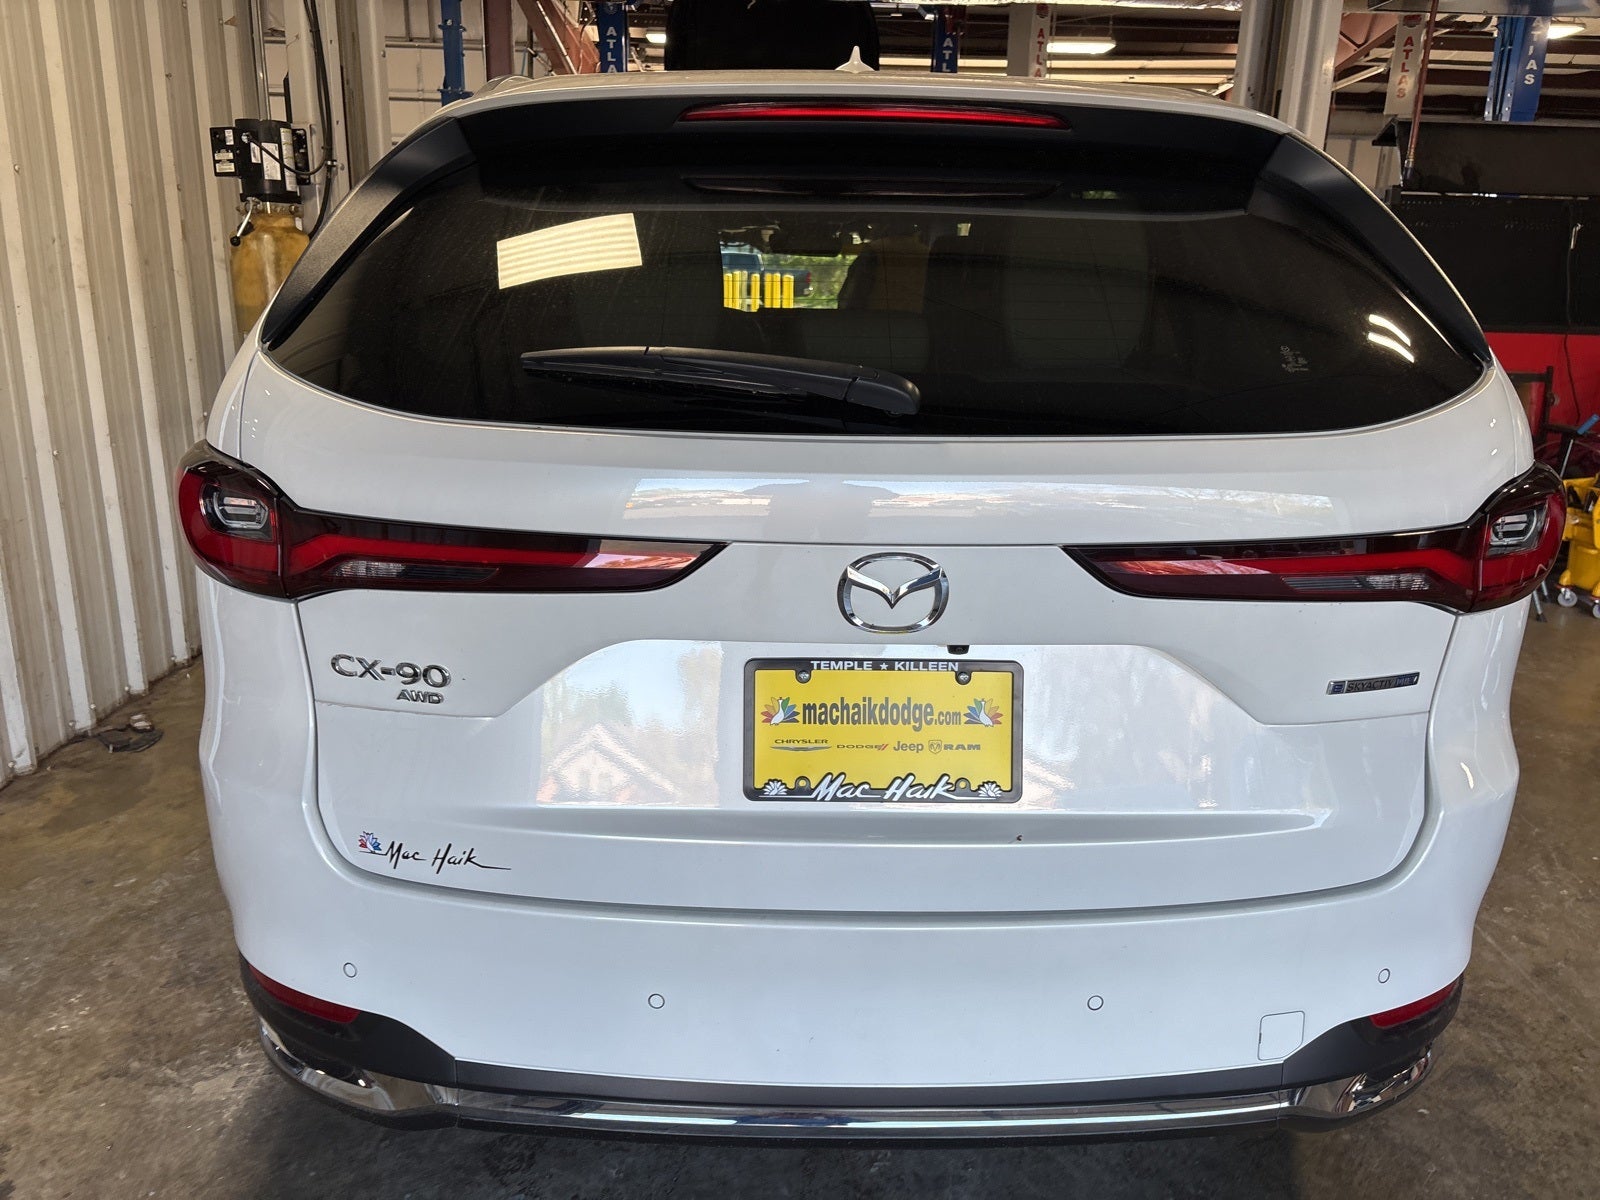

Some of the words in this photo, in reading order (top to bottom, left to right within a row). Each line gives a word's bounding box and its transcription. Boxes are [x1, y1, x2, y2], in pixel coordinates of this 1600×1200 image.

[606, 26, 617, 73] ATLA
[942, 37, 953, 72] ATL
[1034, 28, 1045, 77] ATLA
[1396, 35, 1414, 98] ATLAS
[331, 653, 451, 688] CX-90
[811, 660, 873, 670] TEMPLE
[895, 661, 959, 671] KILLEEN
[396, 689, 444, 704] AWD
[802, 696, 961, 732] machaikdodge.com
[893, 741, 924, 753] Jeep
[811, 774, 881, 801] Mac
[882, 775, 957, 802] Haik
[385, 841, 426, 870] Mac
[432, 843, 511, 874] Haik
